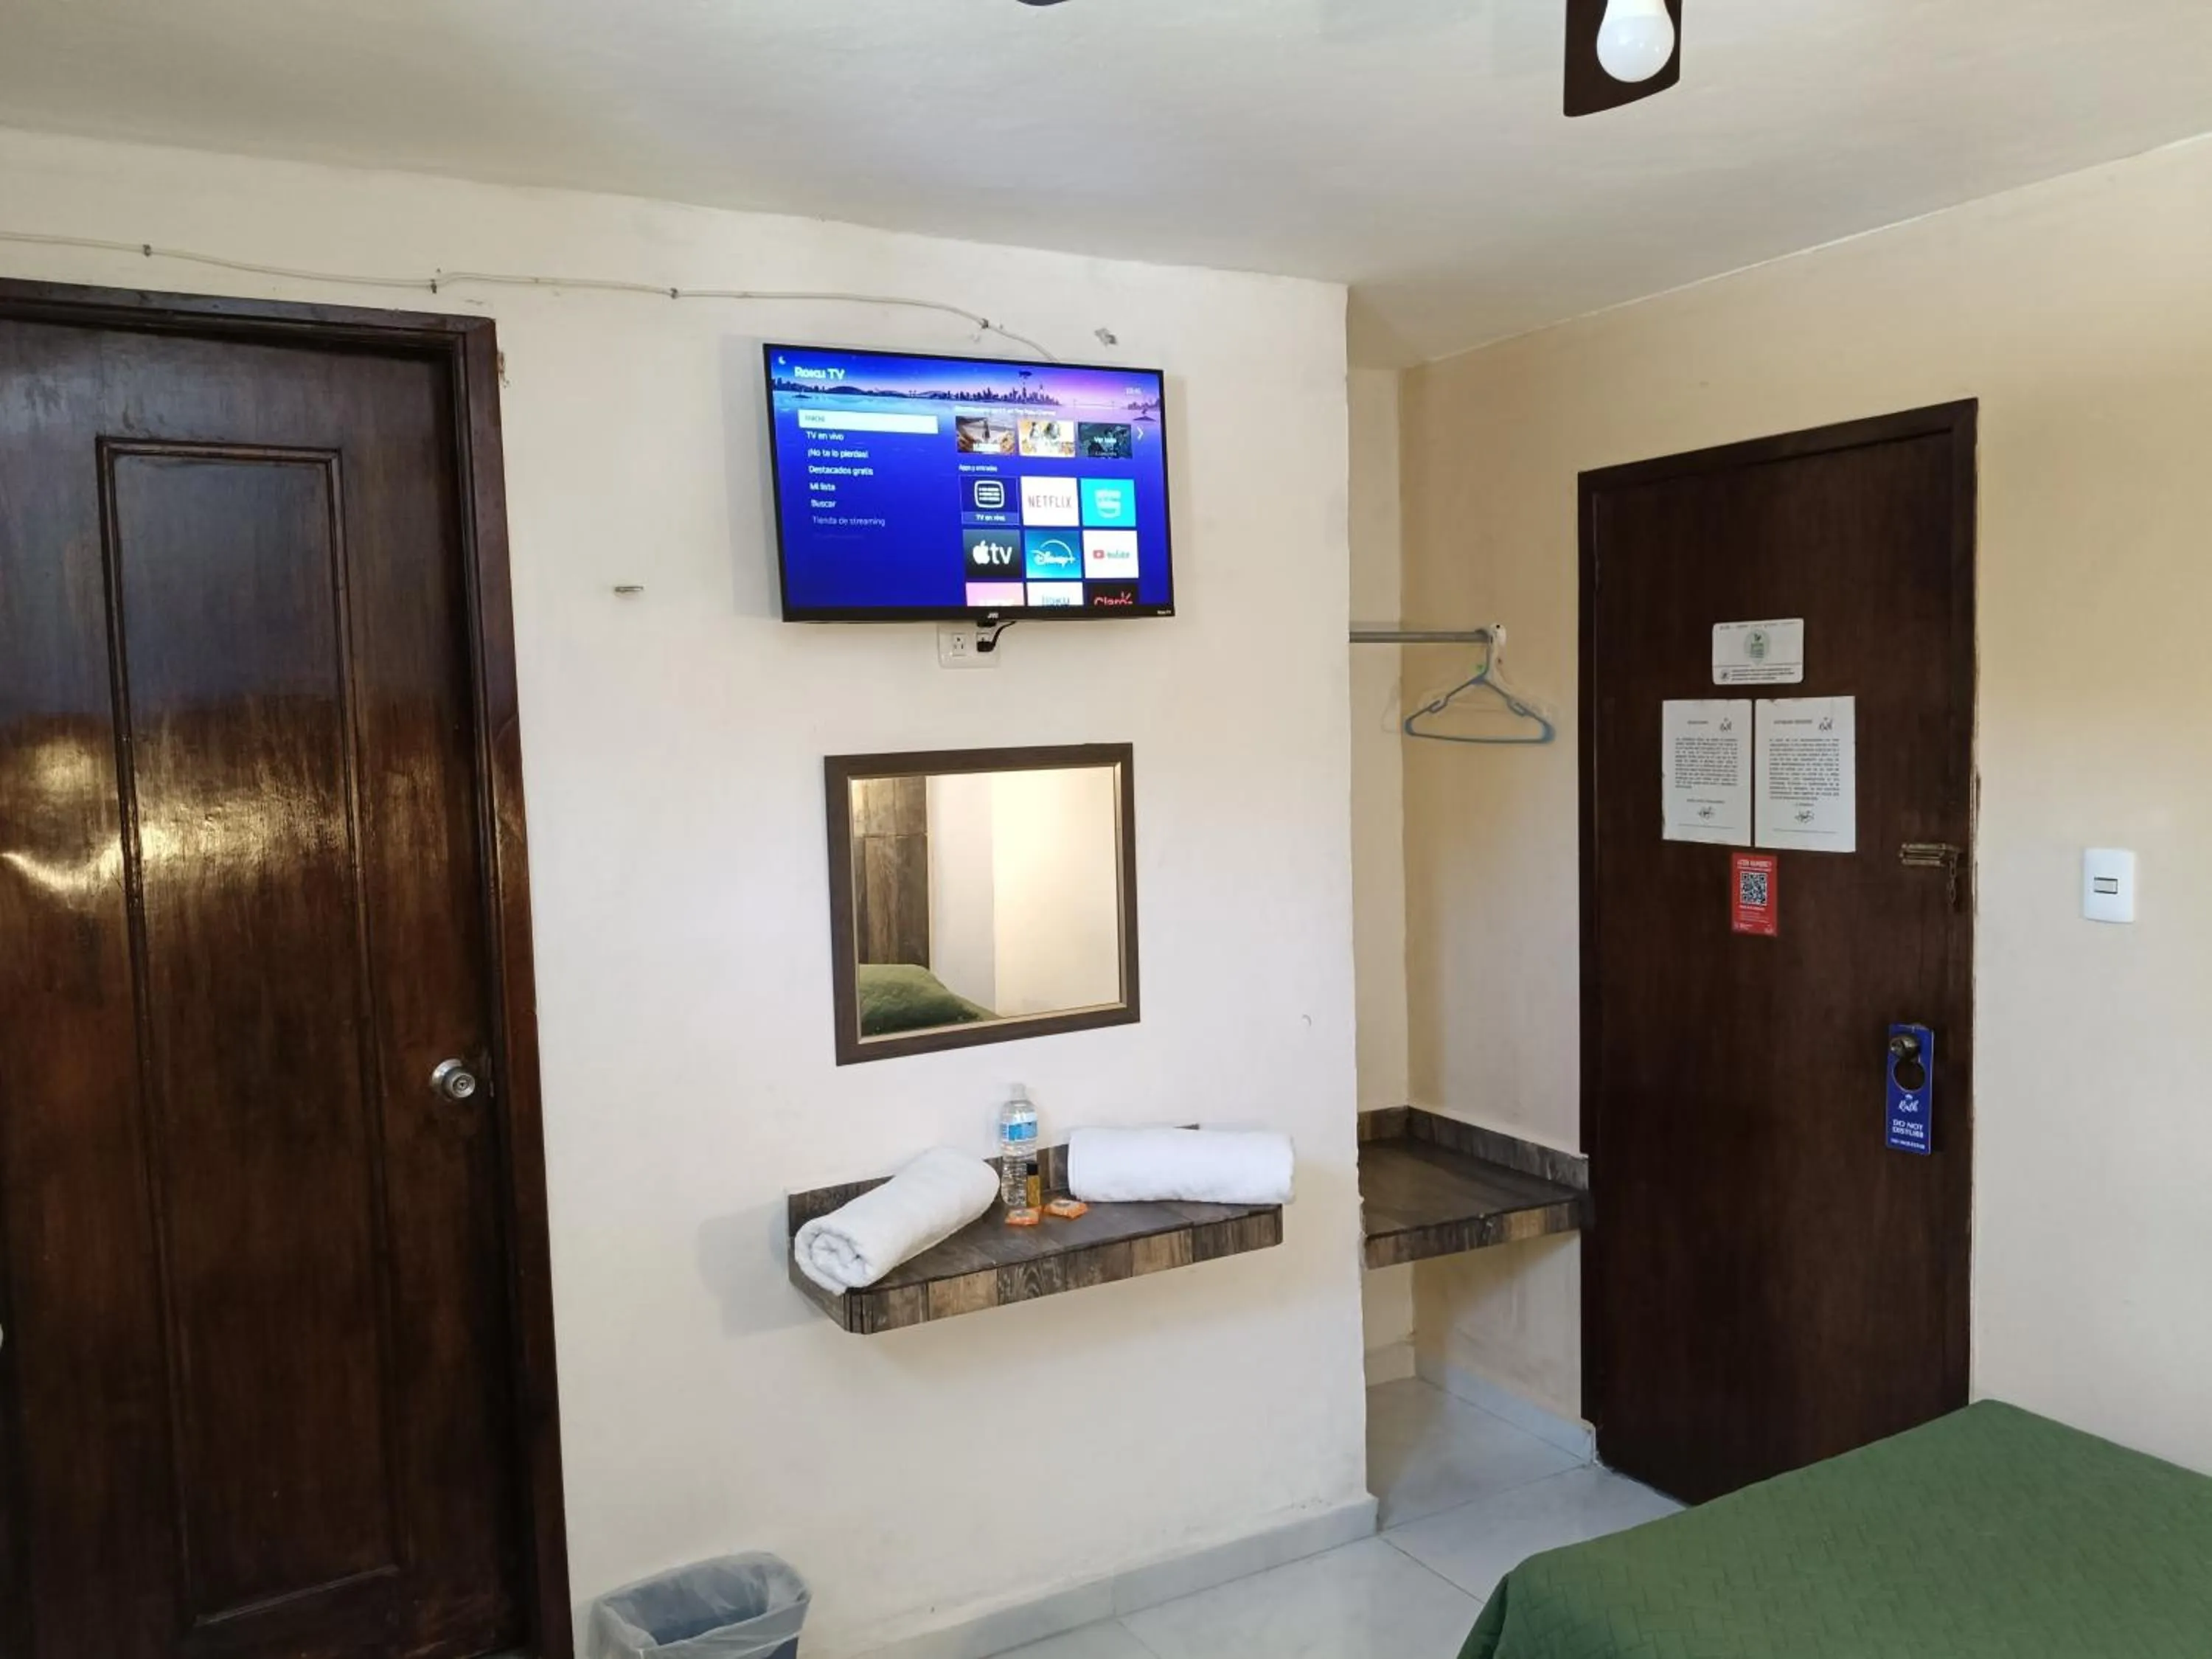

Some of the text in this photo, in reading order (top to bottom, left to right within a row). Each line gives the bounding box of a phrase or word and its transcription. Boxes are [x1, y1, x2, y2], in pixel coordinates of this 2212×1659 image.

[827, 369, 845, 380] TV
[806, 431, 816, 440] TV
[811, 499, 837, 508] Buscar
[1027, 495, 1072, 509] NETFLIX
[849, 518, 886, 528] streaming
[1893, 1119, 1924, 1131] DO NOT
